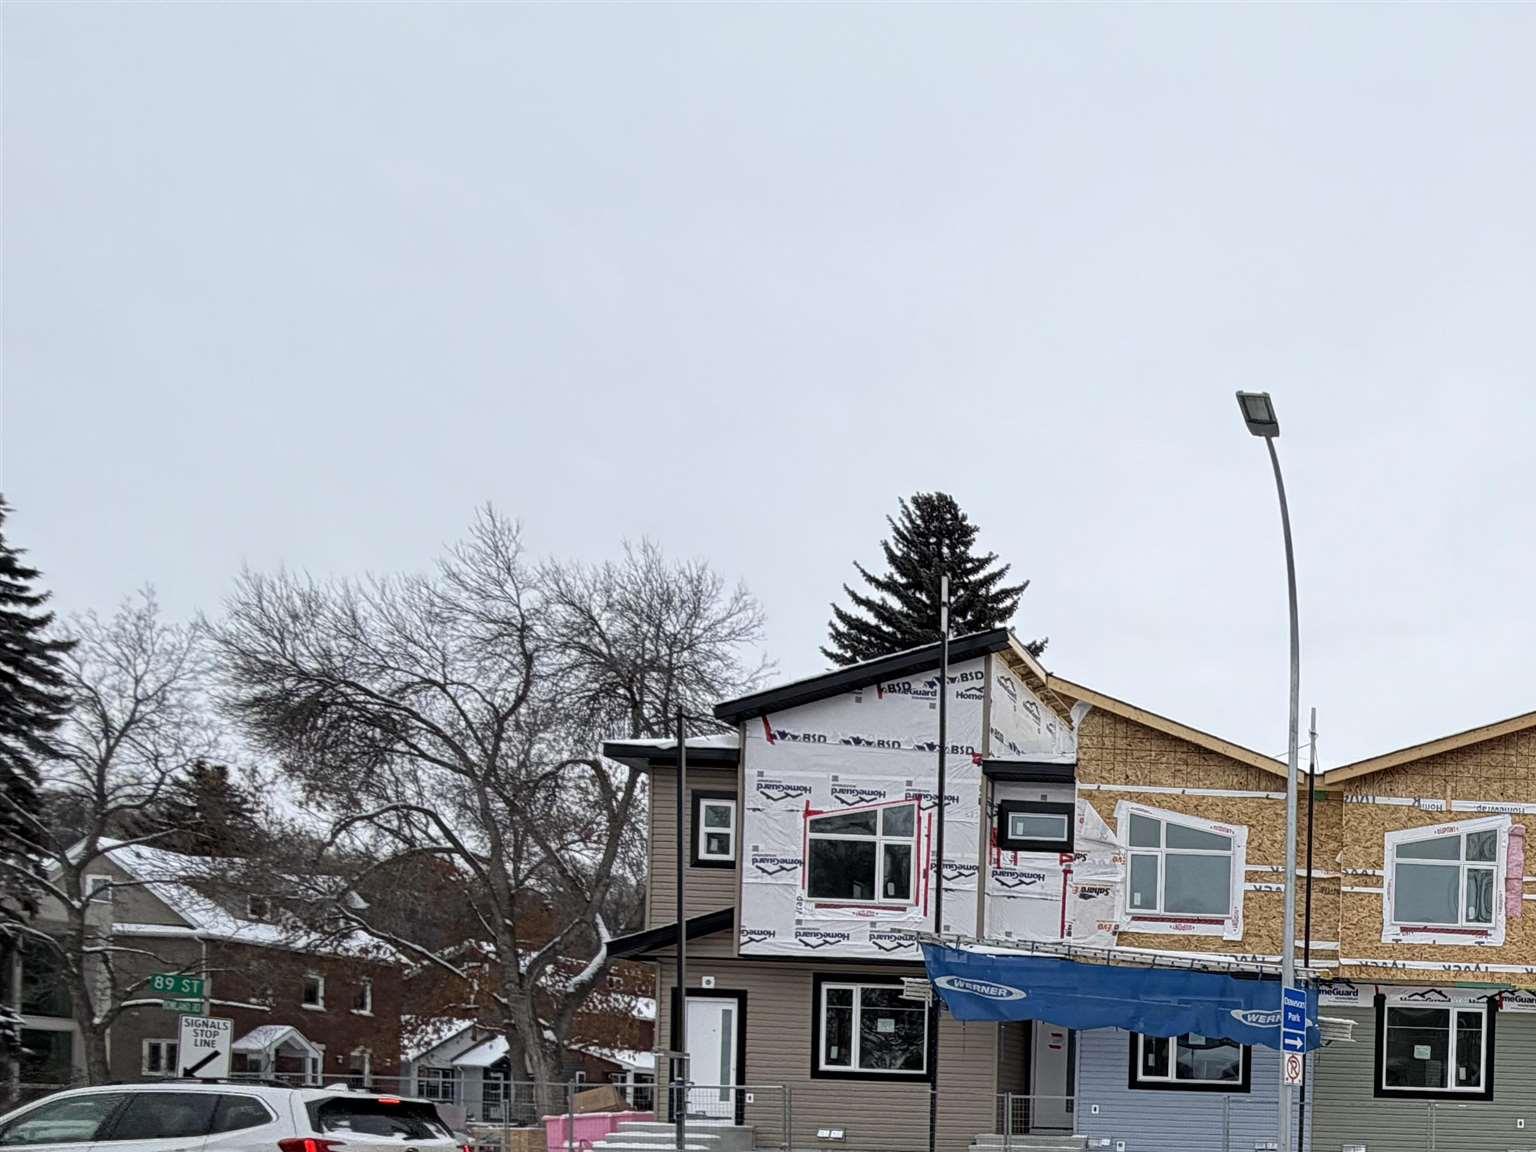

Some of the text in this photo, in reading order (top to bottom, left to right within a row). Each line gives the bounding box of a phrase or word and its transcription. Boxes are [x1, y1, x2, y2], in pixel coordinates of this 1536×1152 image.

[961, 671, 984, 682] BSD
[888, 681, 912, 694] BSD
[803, 734, 827, 744] BSD
[877, 739, 901, 749] BSD
[950, 745, 975, 755] BSD
[756, 782, 812, 794] HomeGuard
[831, 787, 886, 799] HomeGuard
[992, 870, 1046, 882] HomeGuard
[795, 931, 850, 942] HomeGuard
[154, 976, 200, 993] 89 ST
[953, 979, 1008, 997] WERNER
[1288, 1012, 1301, 1022] Park
[184, 1018, 229, 1031] SIGNALS
[192, 1029, 220, 1039] STOP
[193, 1038, 217, 1048] LINE
